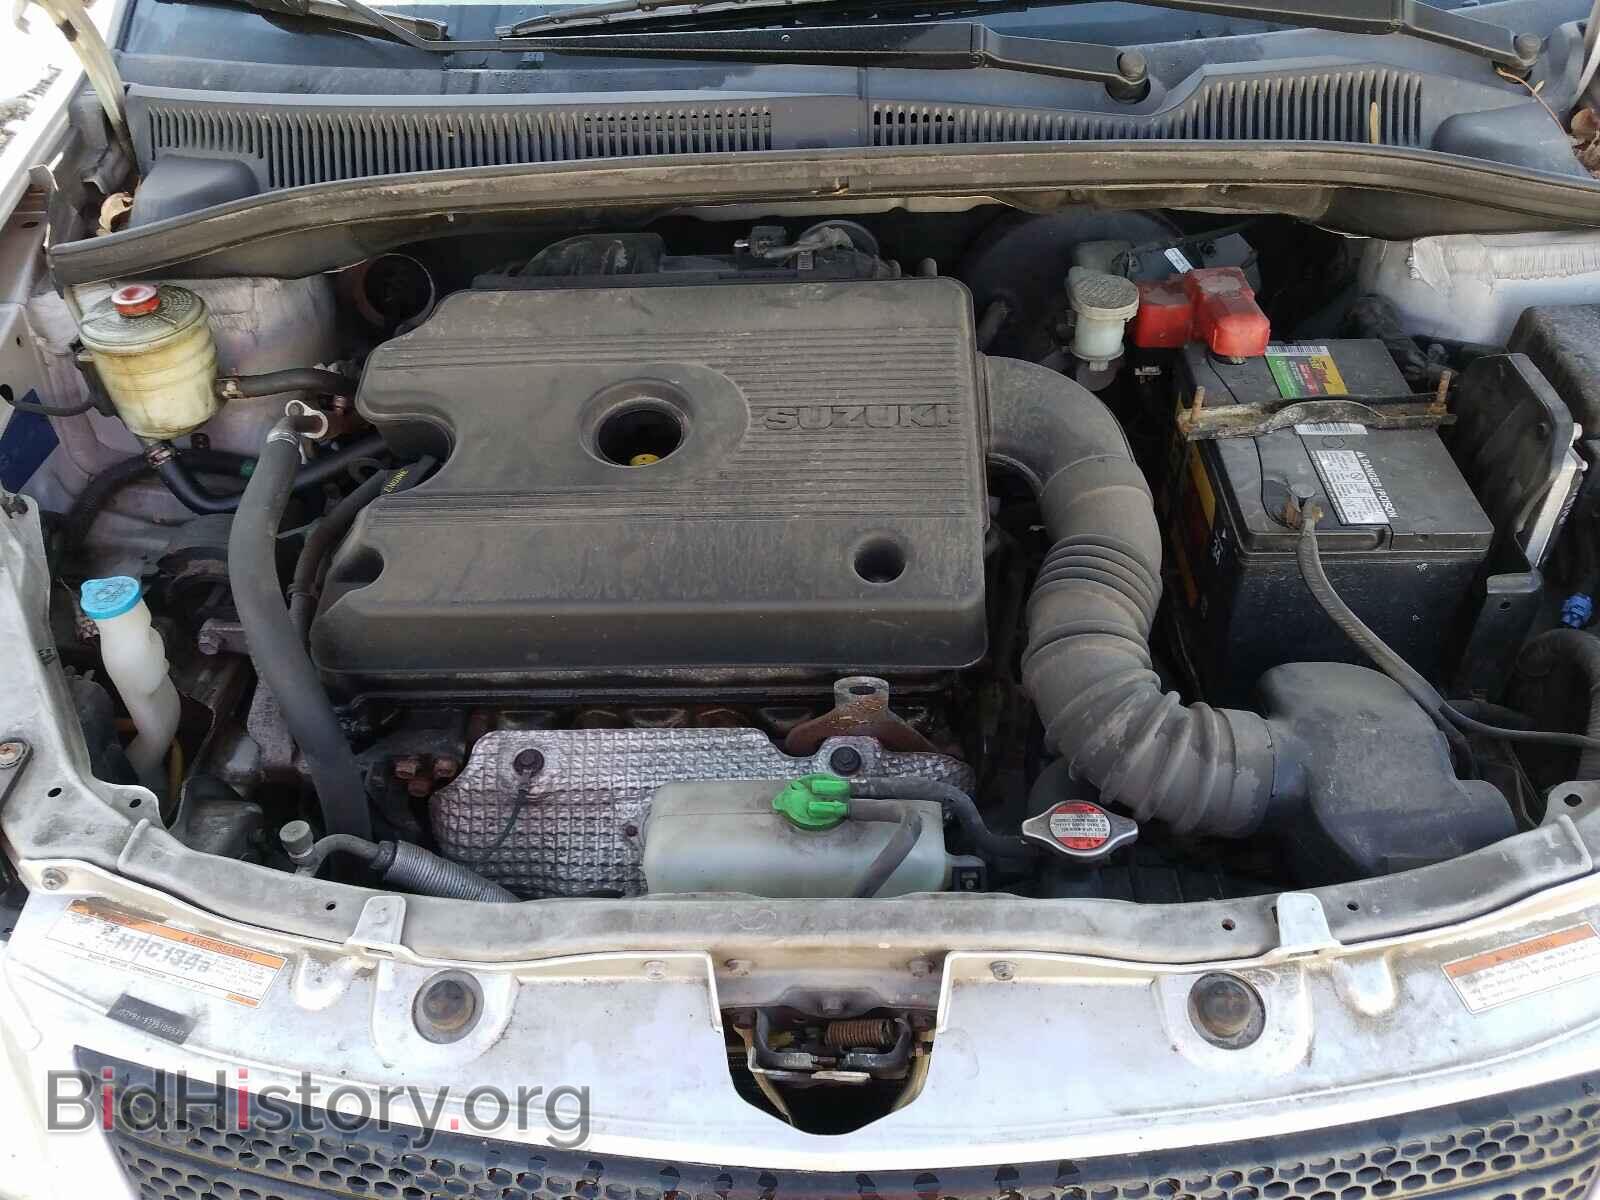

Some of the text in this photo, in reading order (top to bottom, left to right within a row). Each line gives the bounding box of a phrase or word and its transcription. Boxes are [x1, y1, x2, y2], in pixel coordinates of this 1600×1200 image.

[764, 404, 953, 429] SUZUKI
[384, 468, 409, 493] ENGINE
[1360, 460, 1382, 487] DANGER
